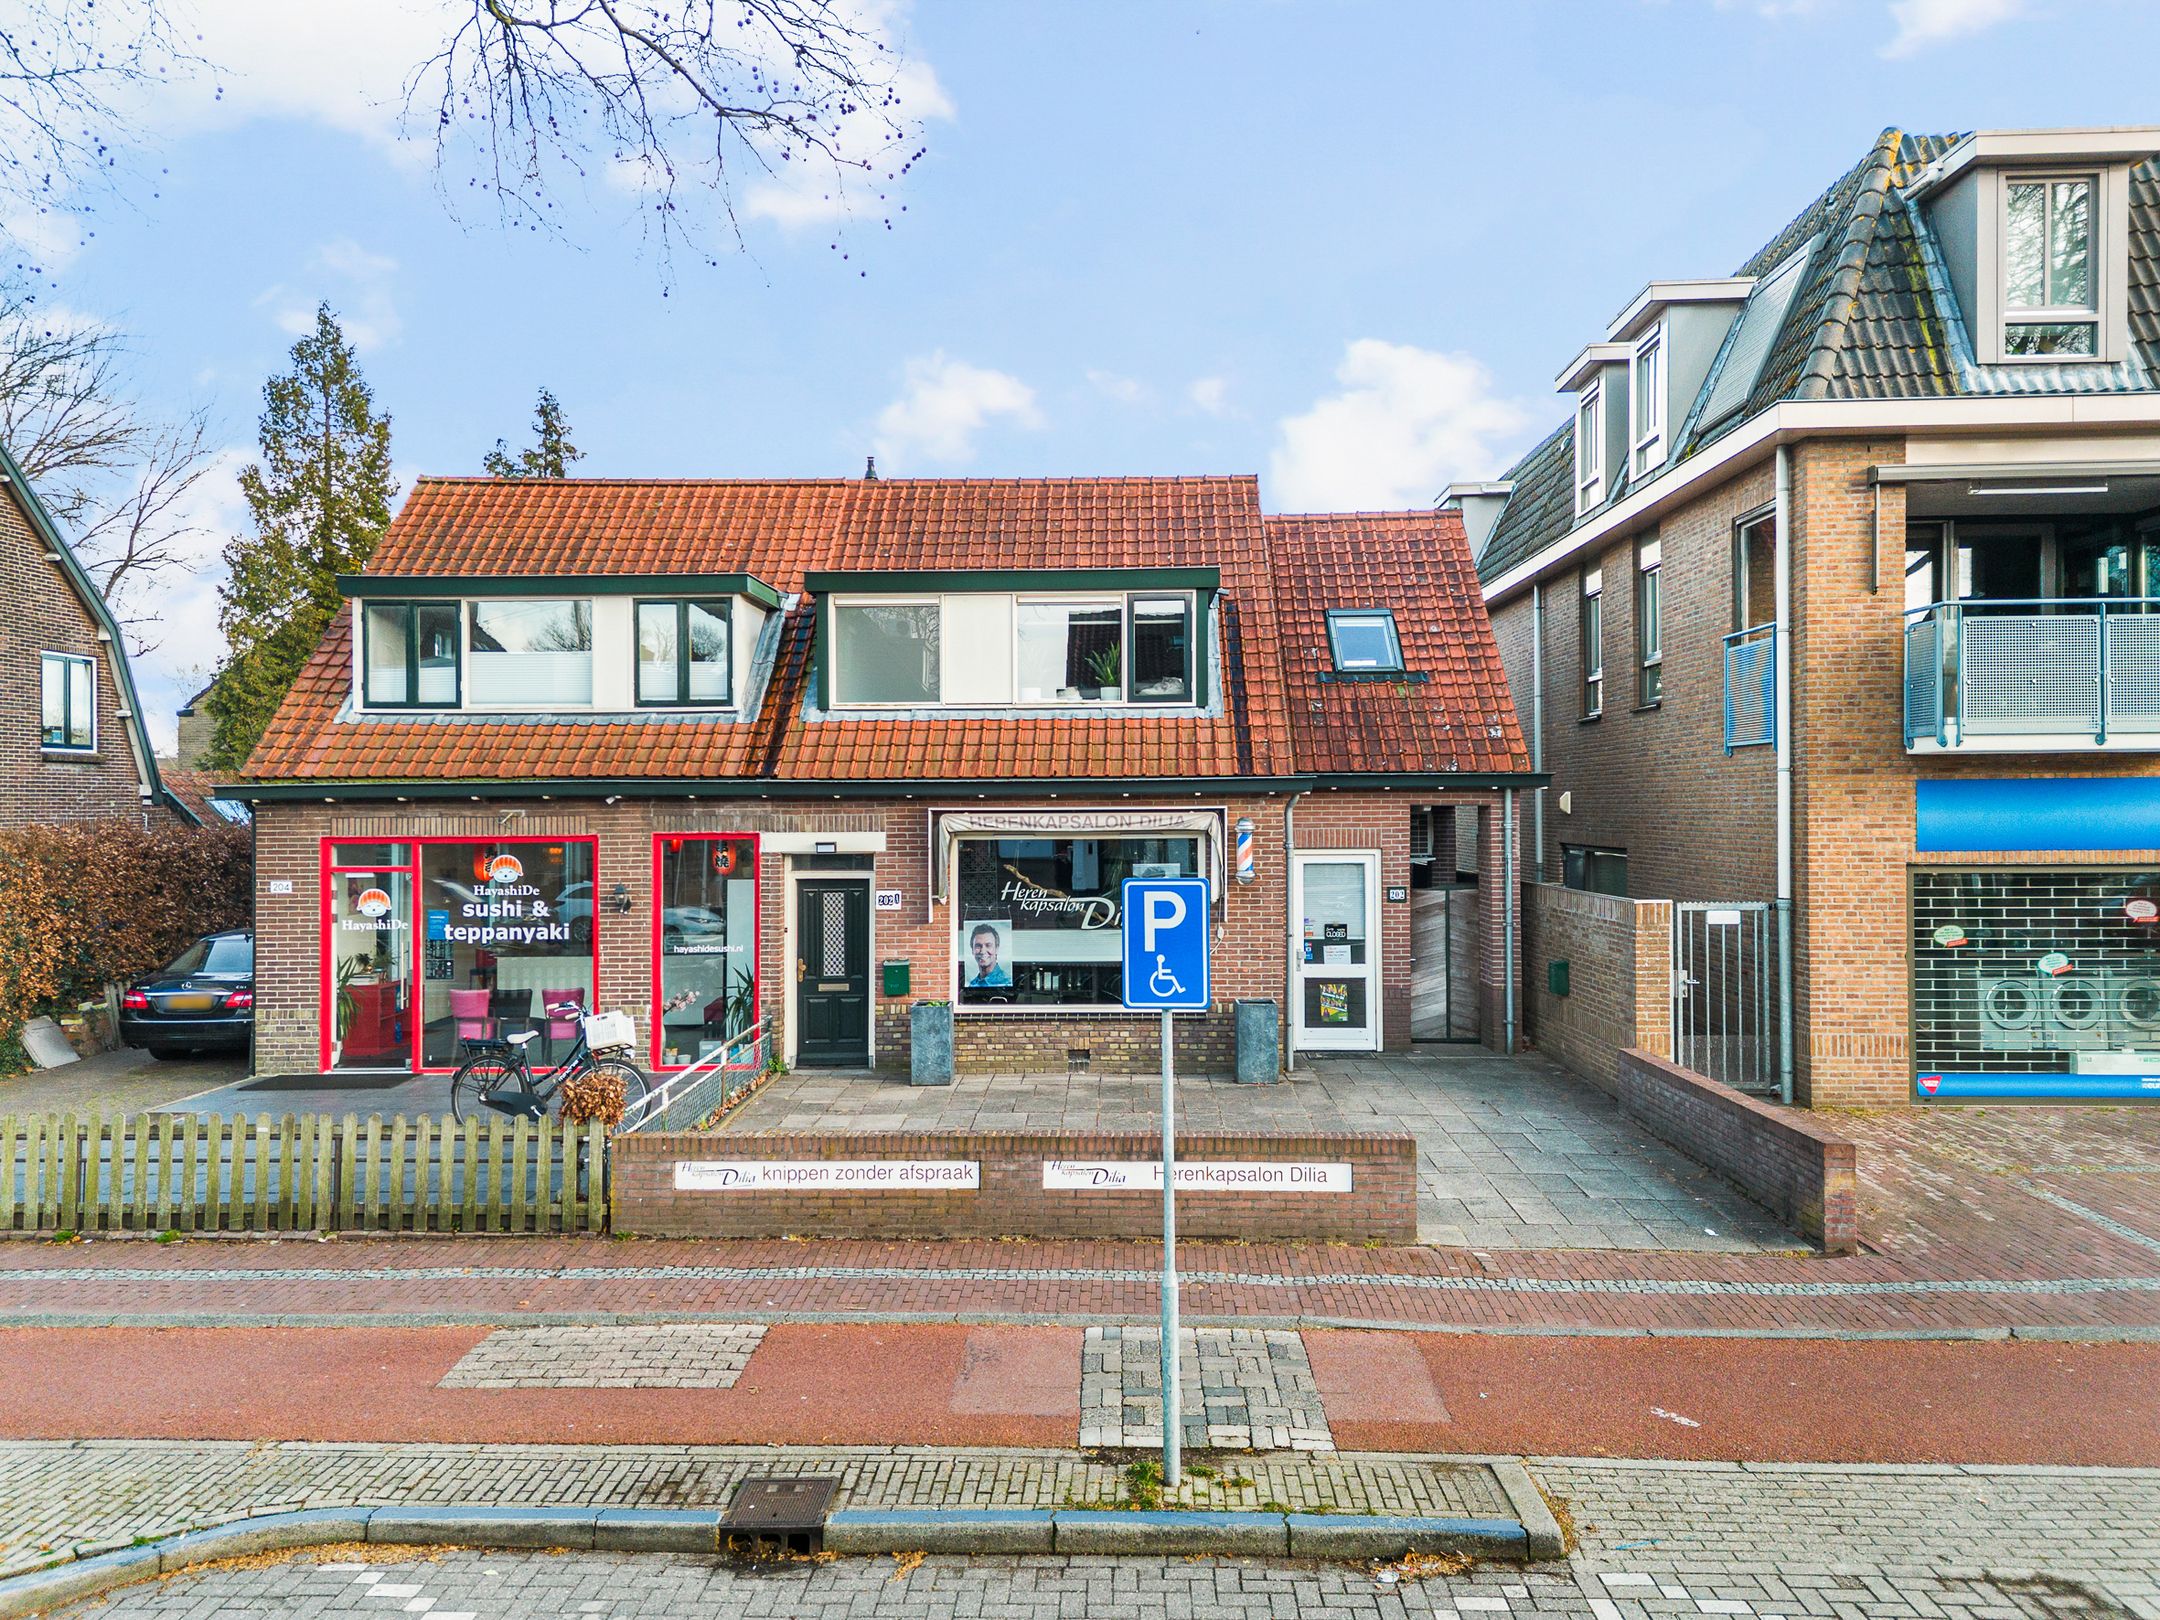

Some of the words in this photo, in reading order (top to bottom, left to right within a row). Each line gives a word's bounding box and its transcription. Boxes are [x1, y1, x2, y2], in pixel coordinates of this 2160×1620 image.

[970, 814, 1132, 829] HERENKAPSALON
[272, 882, 290, 892] 204
[473, 885, 541, 898] HayashiDe
[1000, 881, 1048, 901] Heren
[1389, 889, 1406, 900] 202
[462, 900, 522, 917] sushi
[532, 900, 550, 917] &
[877, 894, 894, 906] 202
[1020, 896, 1084, 917] kapsalon
[341, 919, 409, 932] HayashiDe
[1143, 890, 1187, 952] P
[444, 923, 570, 944] teppanyaki
[673, 945, 744, 955] hayashidesushi.nl
[762, 1165, 830, 1184] knippen
[835, 1165, 894, 1181] zonder
[899, 1164, 974, 1183] afspraak
[1083, 1167, 1127, 1185] Dilia
[1290, 1166, 1328, 1183] Dilia
